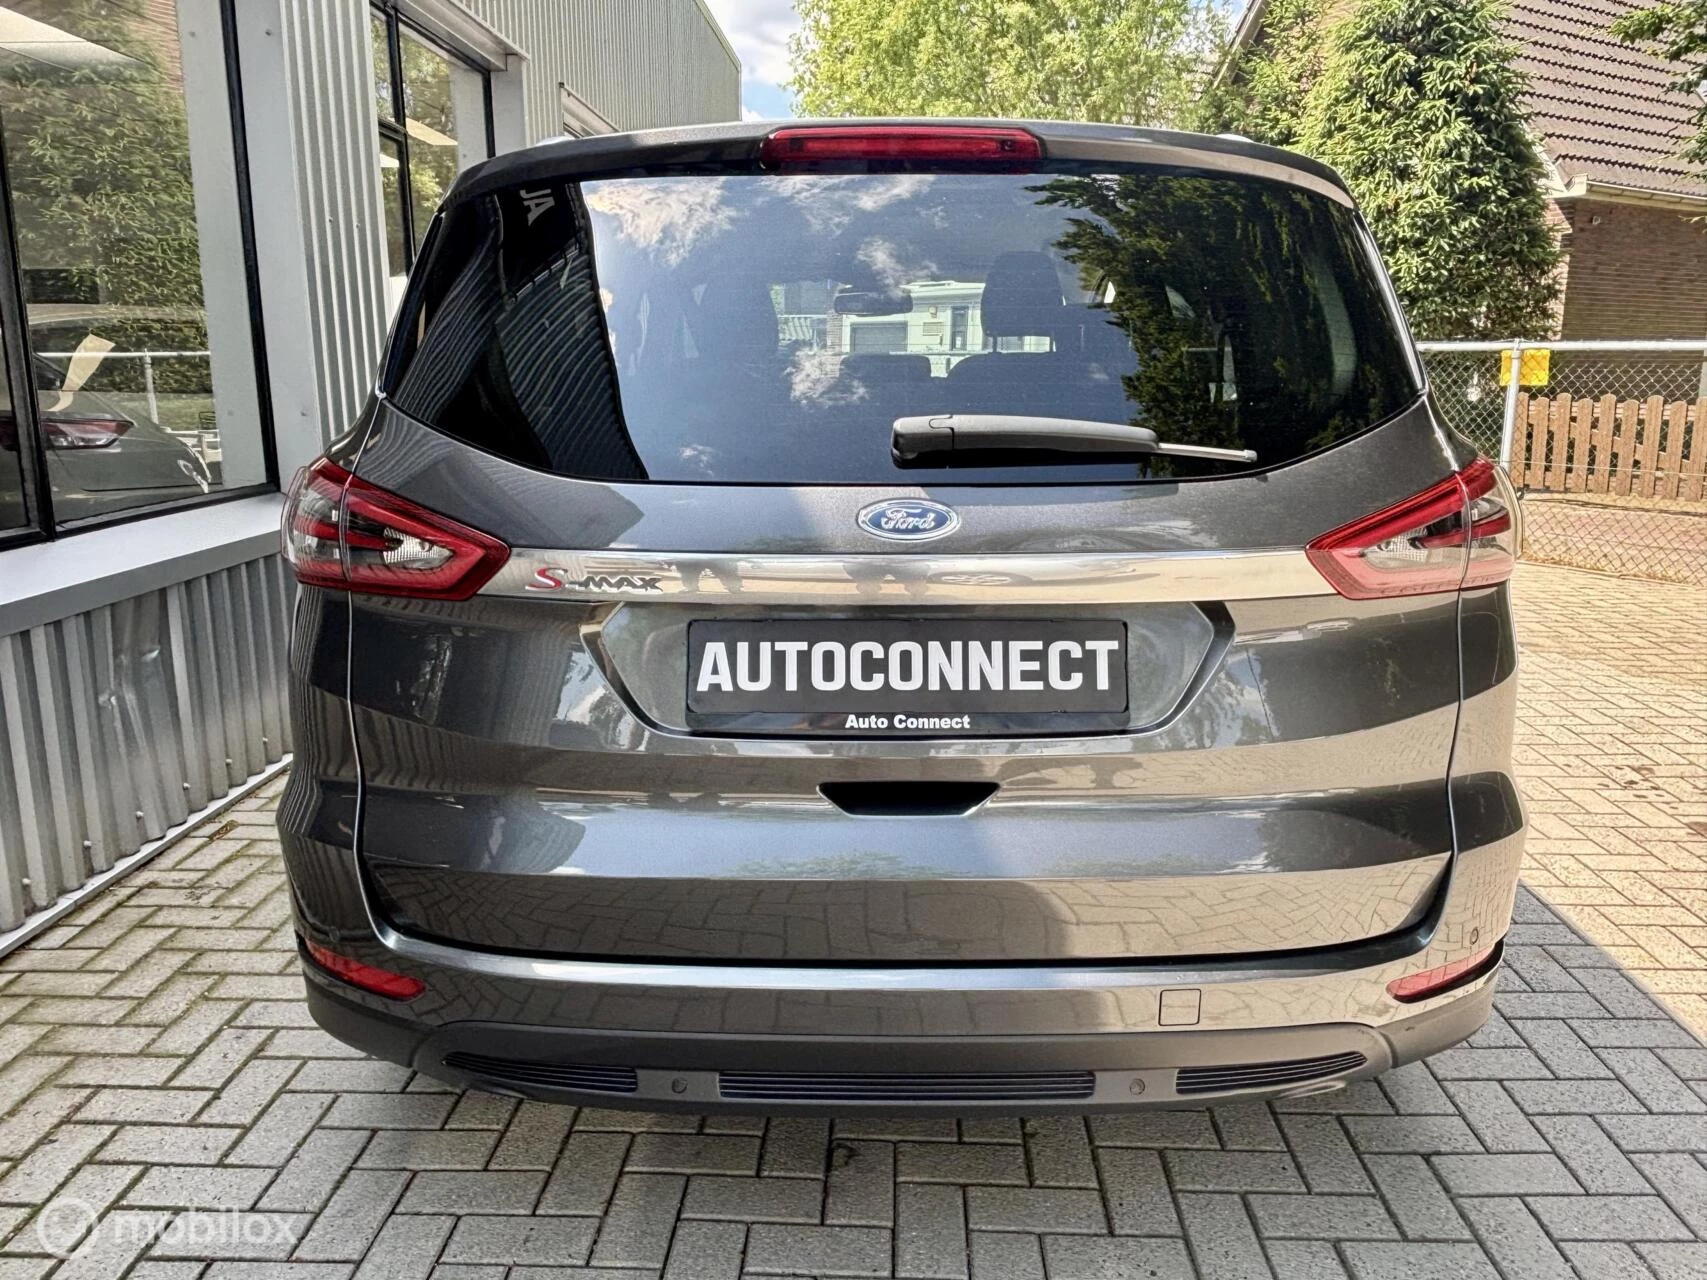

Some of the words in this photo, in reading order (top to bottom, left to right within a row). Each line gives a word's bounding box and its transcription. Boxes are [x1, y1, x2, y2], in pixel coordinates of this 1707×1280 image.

[880, 507, 937, 530] Ford
[525, 566, 664, 593] S-MAX
[696, 640, 1119, 692] AUTOCONNECT
[845, 714, 888, 729] Auto
[893, 714, 971, 729] Connect
